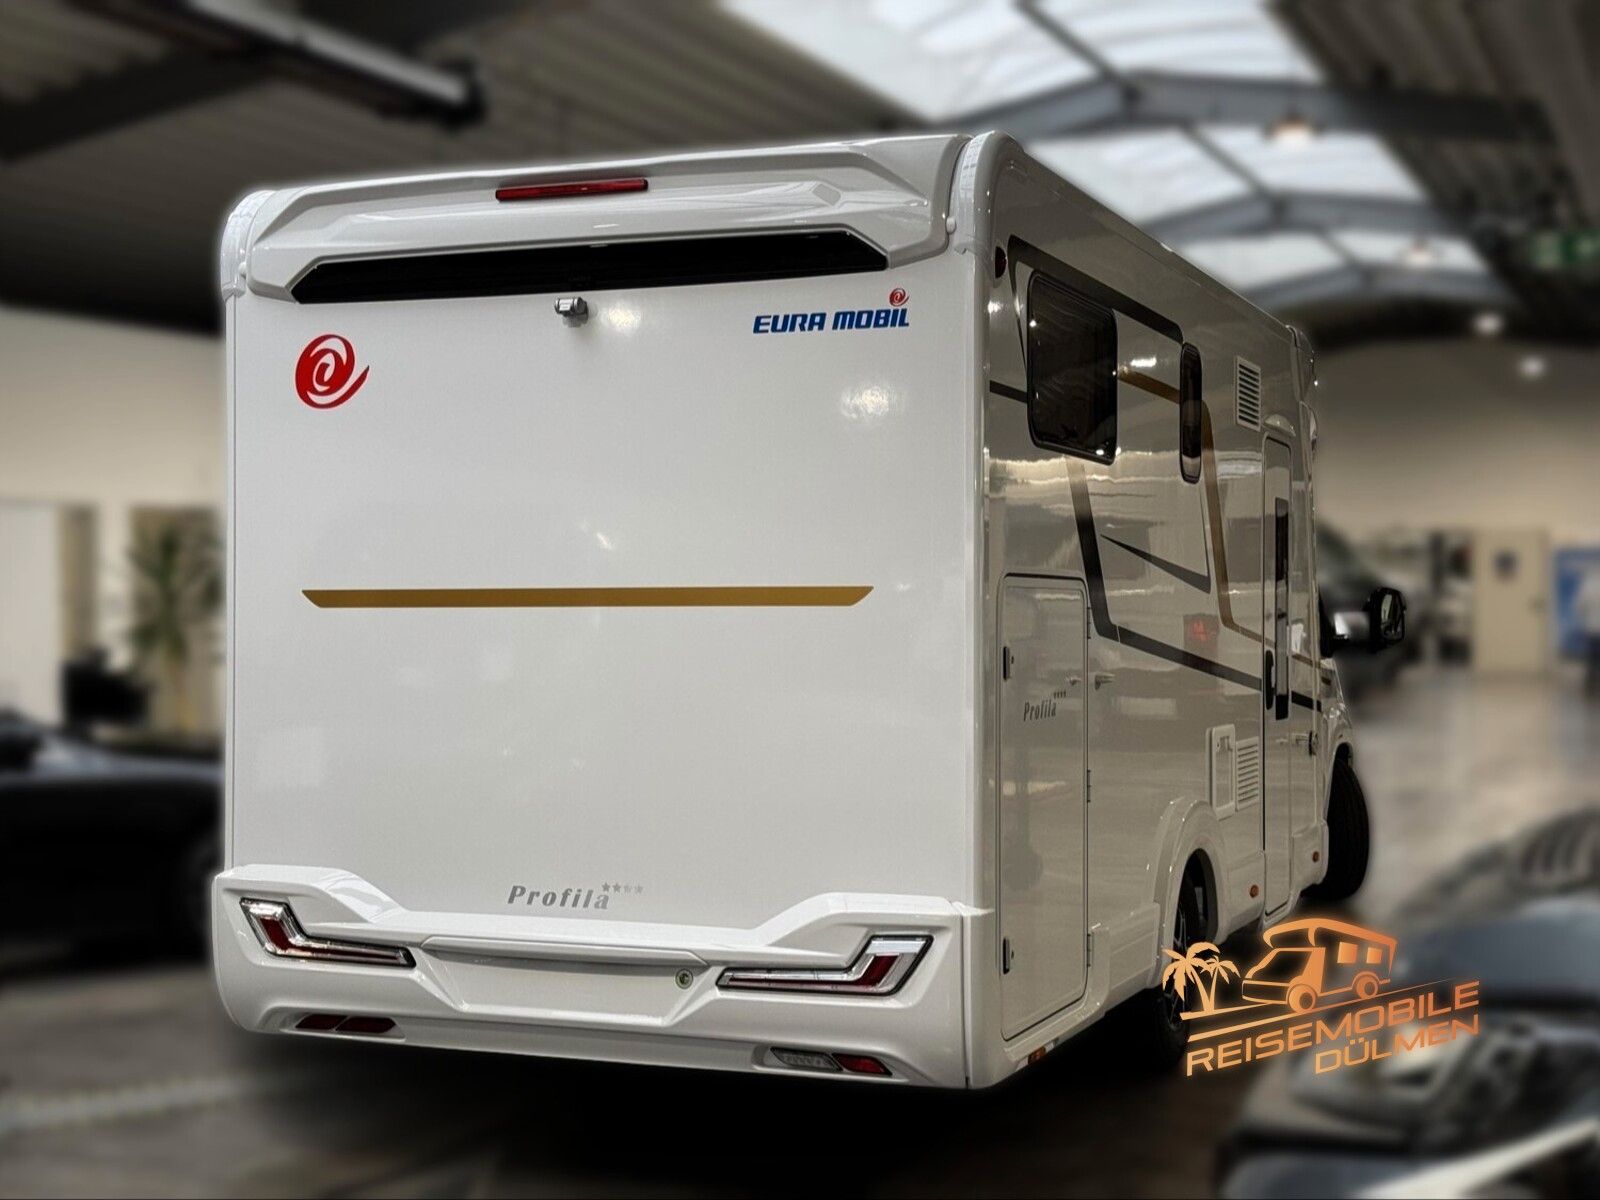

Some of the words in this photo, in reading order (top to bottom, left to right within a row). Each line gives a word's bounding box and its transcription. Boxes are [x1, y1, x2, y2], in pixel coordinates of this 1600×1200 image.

[753, 312, 826, 334] EURA
[832, 308, 909, 330] MOBIL
[1023, 699, 1056, 722] Profila
[507, 885, 610, 910] Profila
